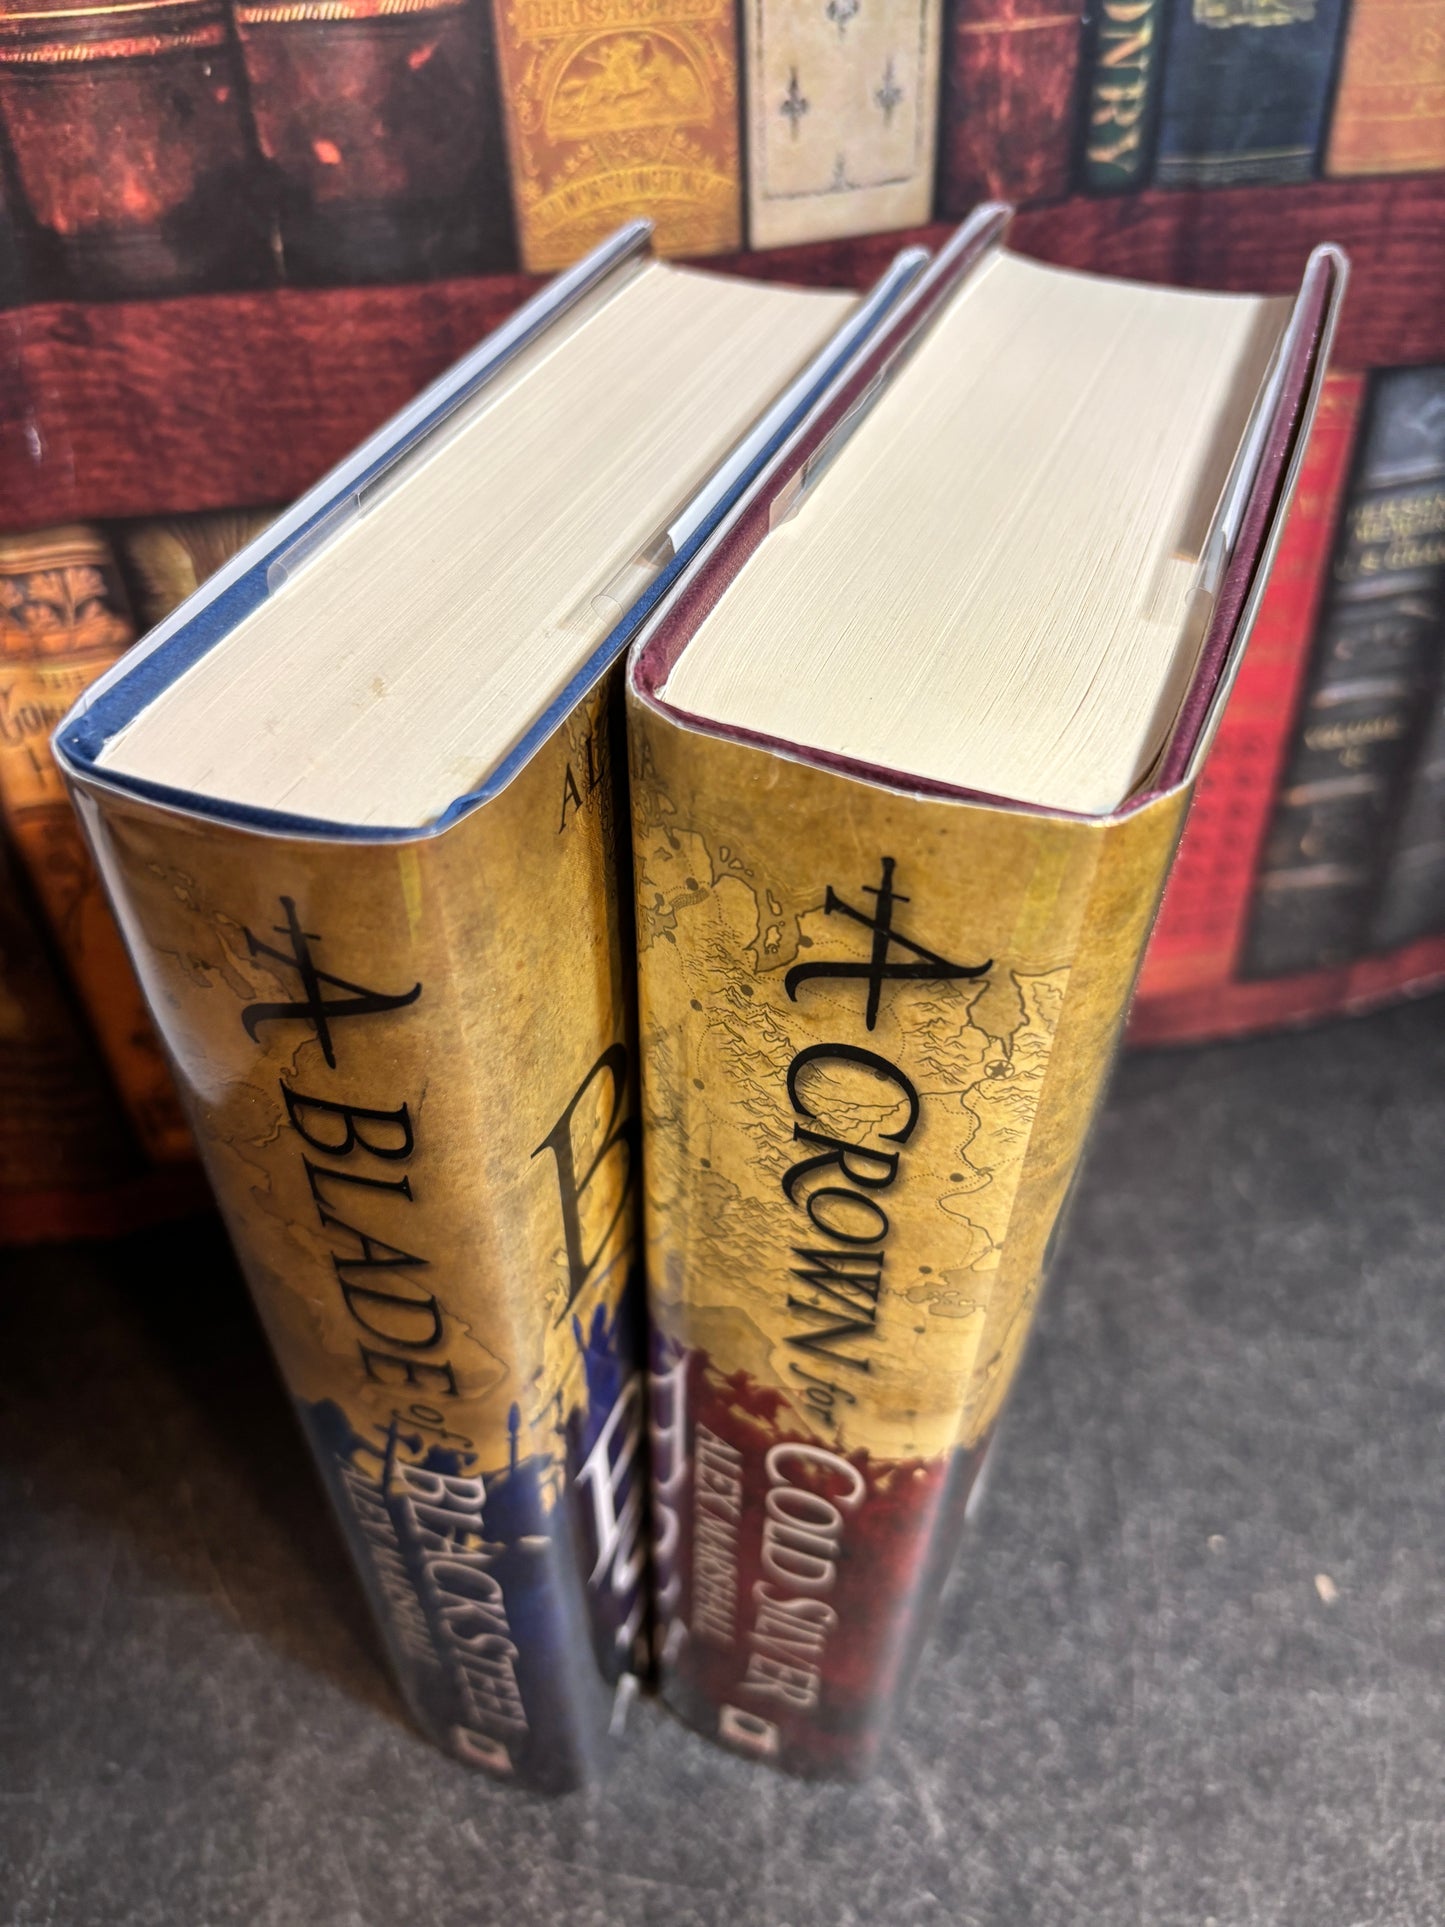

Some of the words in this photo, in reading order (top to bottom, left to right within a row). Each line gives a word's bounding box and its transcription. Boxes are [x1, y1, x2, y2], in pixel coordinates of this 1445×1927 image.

[242, 895, 422, 1070] A
[784, 856, 994, 1032] A
[279, 1077, 460, 1397] BLADE
[781, 1042, 920, 1374] CROWN
[391, 1404, 475, 1449] of
[789, 1362, 857, 1428] for
[694, 1421, 744, 1522] ALEX
[763, 1443, 866, 1586] COLD
[392, 1456, 512, 1634] BLACK
[690, 1511, 740, 1645] MARSHALL
[440, 1612, 530, 1734] STEEL
[740, 1579, 840, 1707] SILVER
